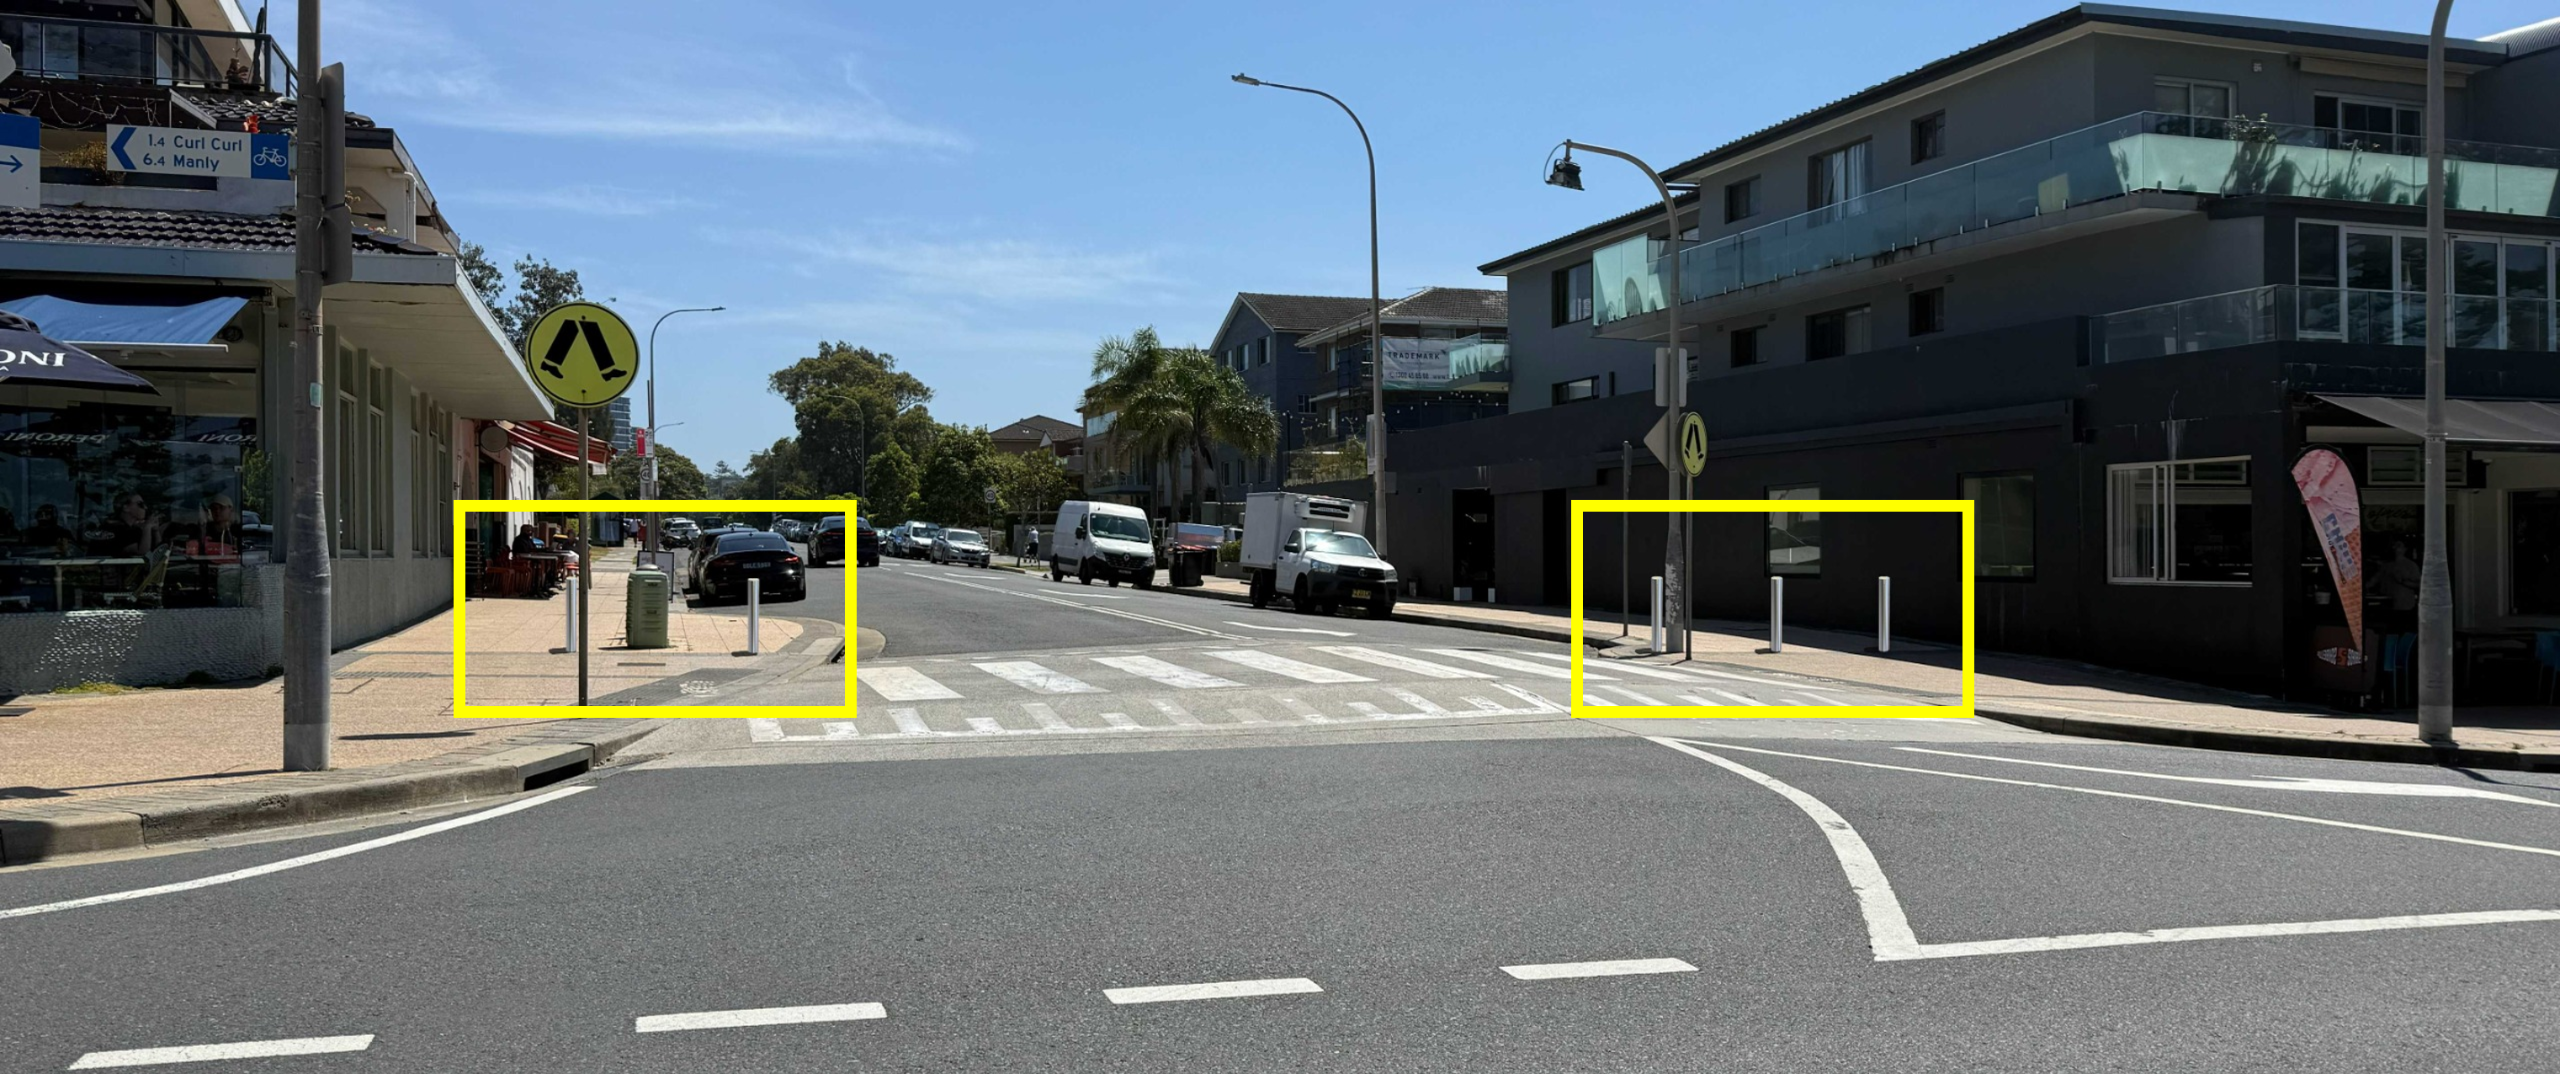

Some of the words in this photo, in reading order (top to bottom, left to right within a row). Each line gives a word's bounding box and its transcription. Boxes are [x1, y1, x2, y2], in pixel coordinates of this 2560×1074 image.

[148, 134, 165, 147] 1.4
[173, 135, 205, 149] Curl
[211, 138, 242, 152] Curl
[143, 153, 165, 167] 6.4
[173, 154, 220, 172] Manly
[1388, 351, 1440, 360] TRADEMARK
